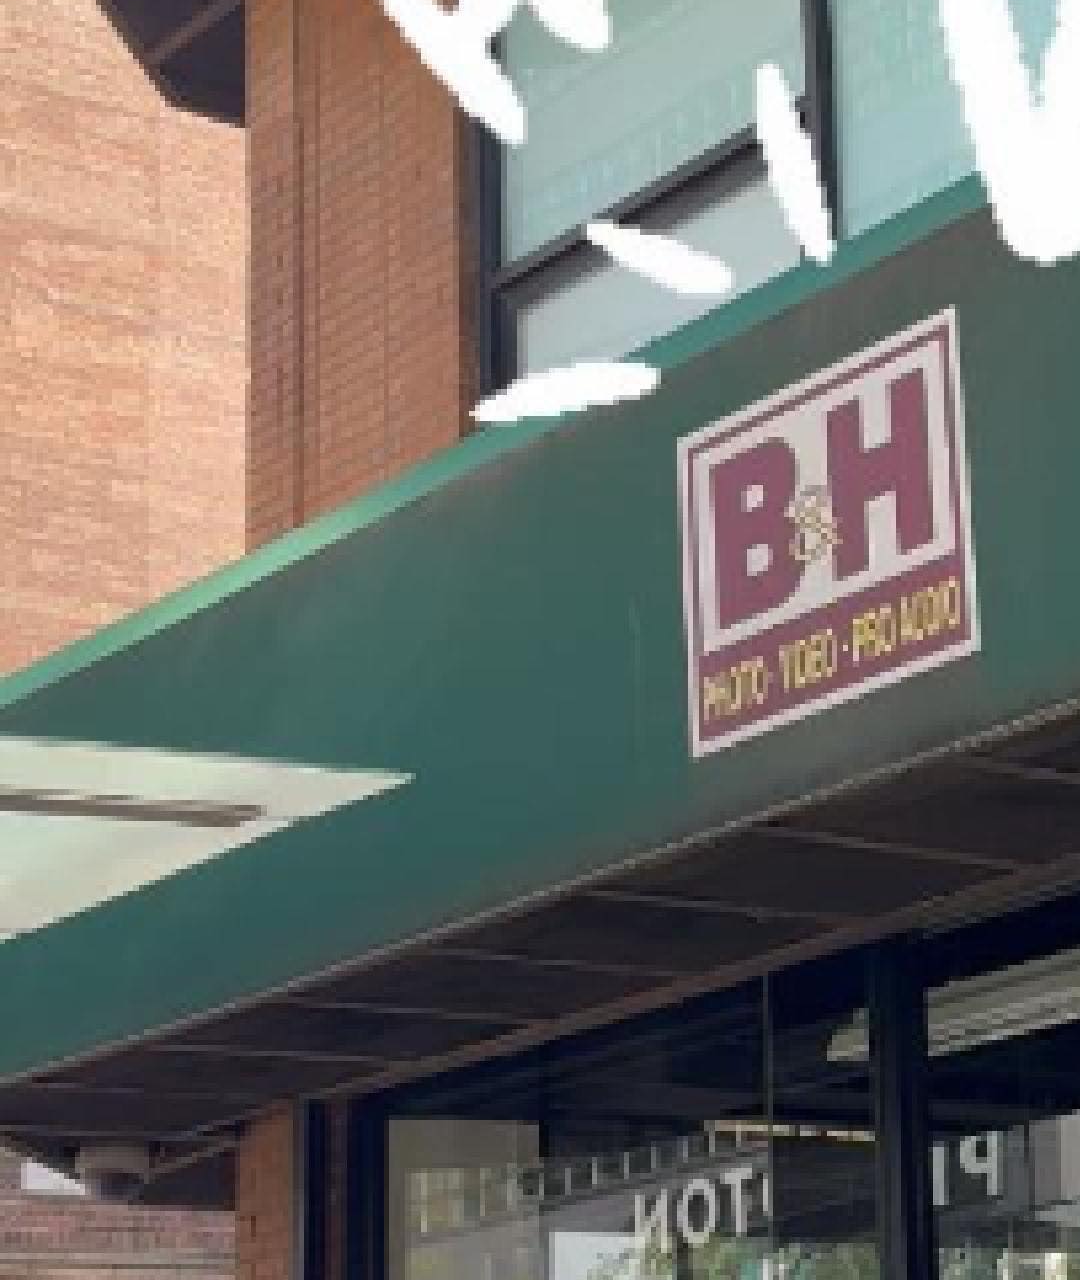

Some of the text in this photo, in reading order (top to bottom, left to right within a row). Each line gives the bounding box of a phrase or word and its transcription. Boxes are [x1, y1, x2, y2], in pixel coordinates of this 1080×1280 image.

[709, 367, 935, 629] B&H
[703, 576, 961, 722] PHOTO VIDEO PRO AUDIO
